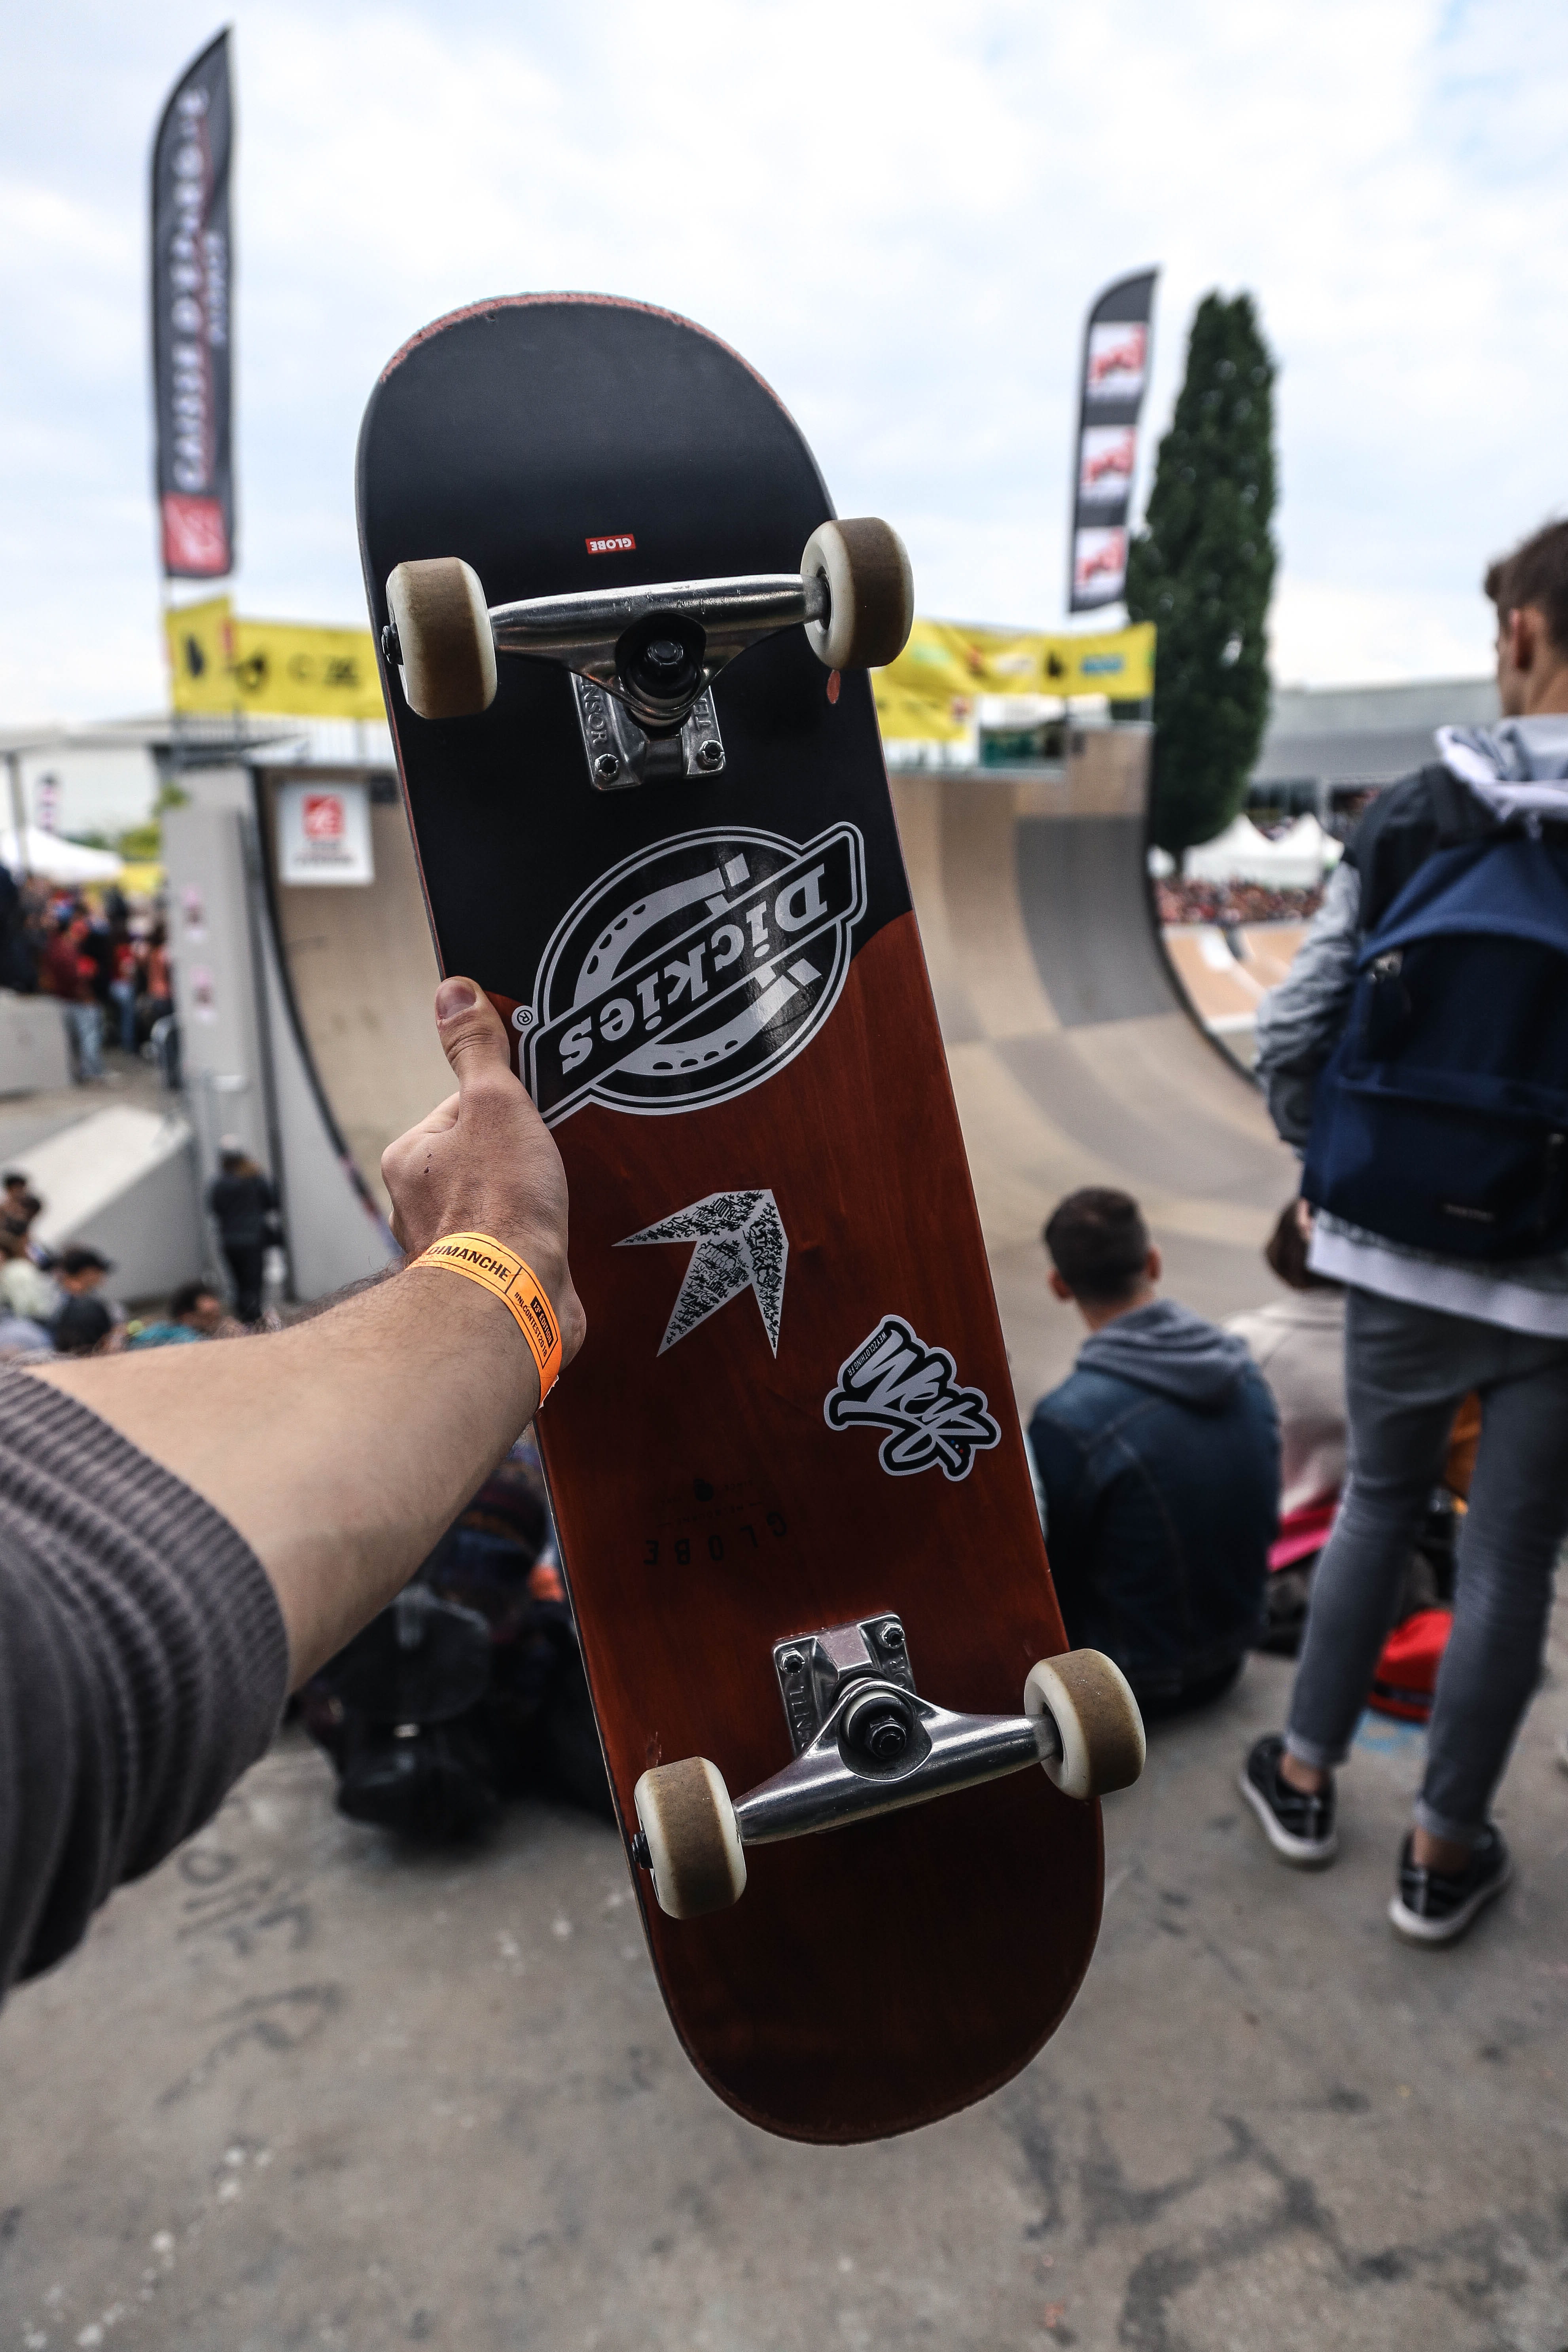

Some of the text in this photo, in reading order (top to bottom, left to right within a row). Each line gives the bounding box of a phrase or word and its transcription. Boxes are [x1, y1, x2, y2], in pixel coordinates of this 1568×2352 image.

[589, 537, 632, 551] GLOBE
[580, 676, 608, 744] NSOR
[559, 863, 828, 1075] Dickies
[428, 1246, 511, 1282] DIMANCHE
[514, 1292, 547, 1358] #NLCONTEST2018
[540, 1312, 553, 1344] ÉDITION
[847, 1331, 888, 1376] WEYZCLOTHING.FR
[643, 1512, 787, 1566] GLOBE
